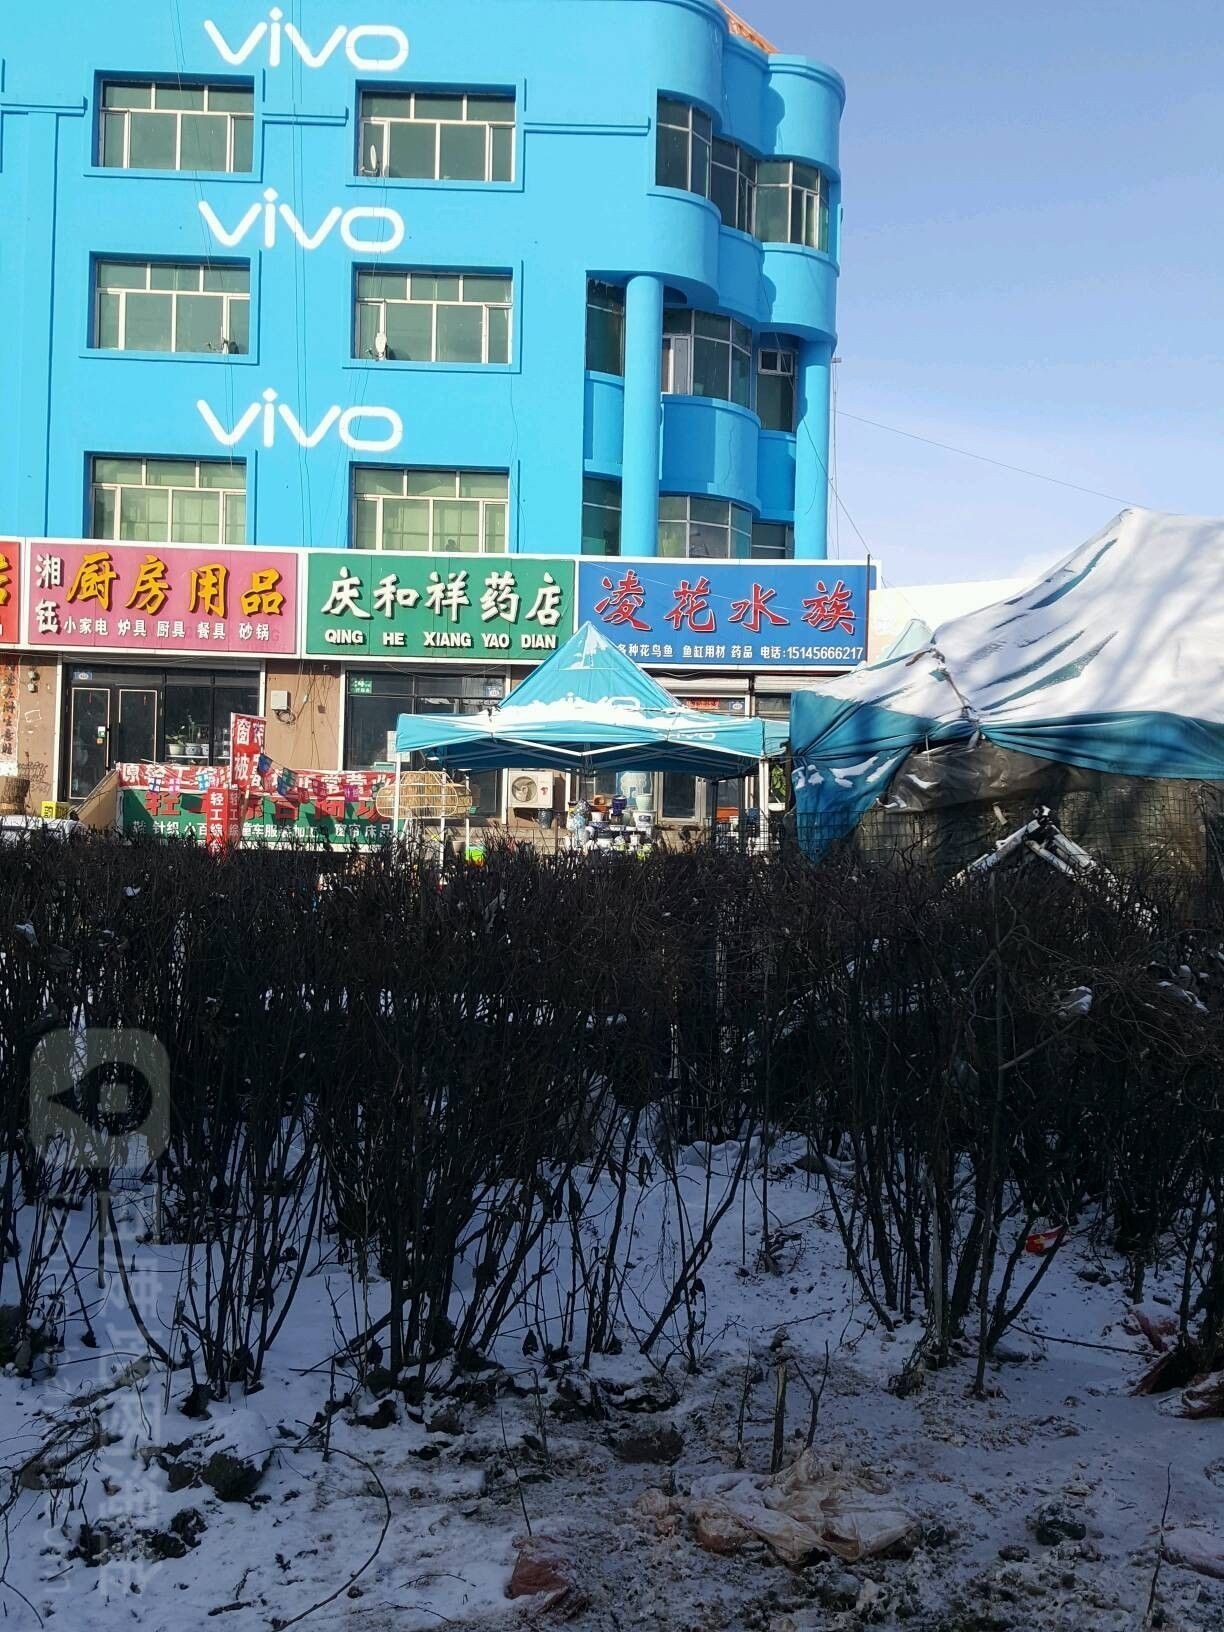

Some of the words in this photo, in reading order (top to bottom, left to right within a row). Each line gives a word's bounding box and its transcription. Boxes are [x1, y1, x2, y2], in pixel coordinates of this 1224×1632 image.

[203, 6, 410, 71] vivo
[198, 186, 406, 254] vivo
[196, 387, 404, 453] vivo
[66, 550, 285, 618] 厨房用品
[321, 565, 563, 627] 庆和祥药店
[593, 569, 857, 635] 凌花水族
[64, 616, 109, 636] 小家电
[117, 618, 148, 638] 炉具
[156, 619, 186, 639] 厨具
[197, 621, 226, 640] 餐具
[238, 622, 271, 642] 砂锅
[324, 628, 364, 645] QING
[383, 631, 405, 646] HE
[423, 631, 472, 648] XIANG
[481, 632, 510, 649] YAO
[520, 633, 558, 650] DIAN
[682, 645, 726, 660] 鱼缸用材
[731, 646, 754, 660] 药品
